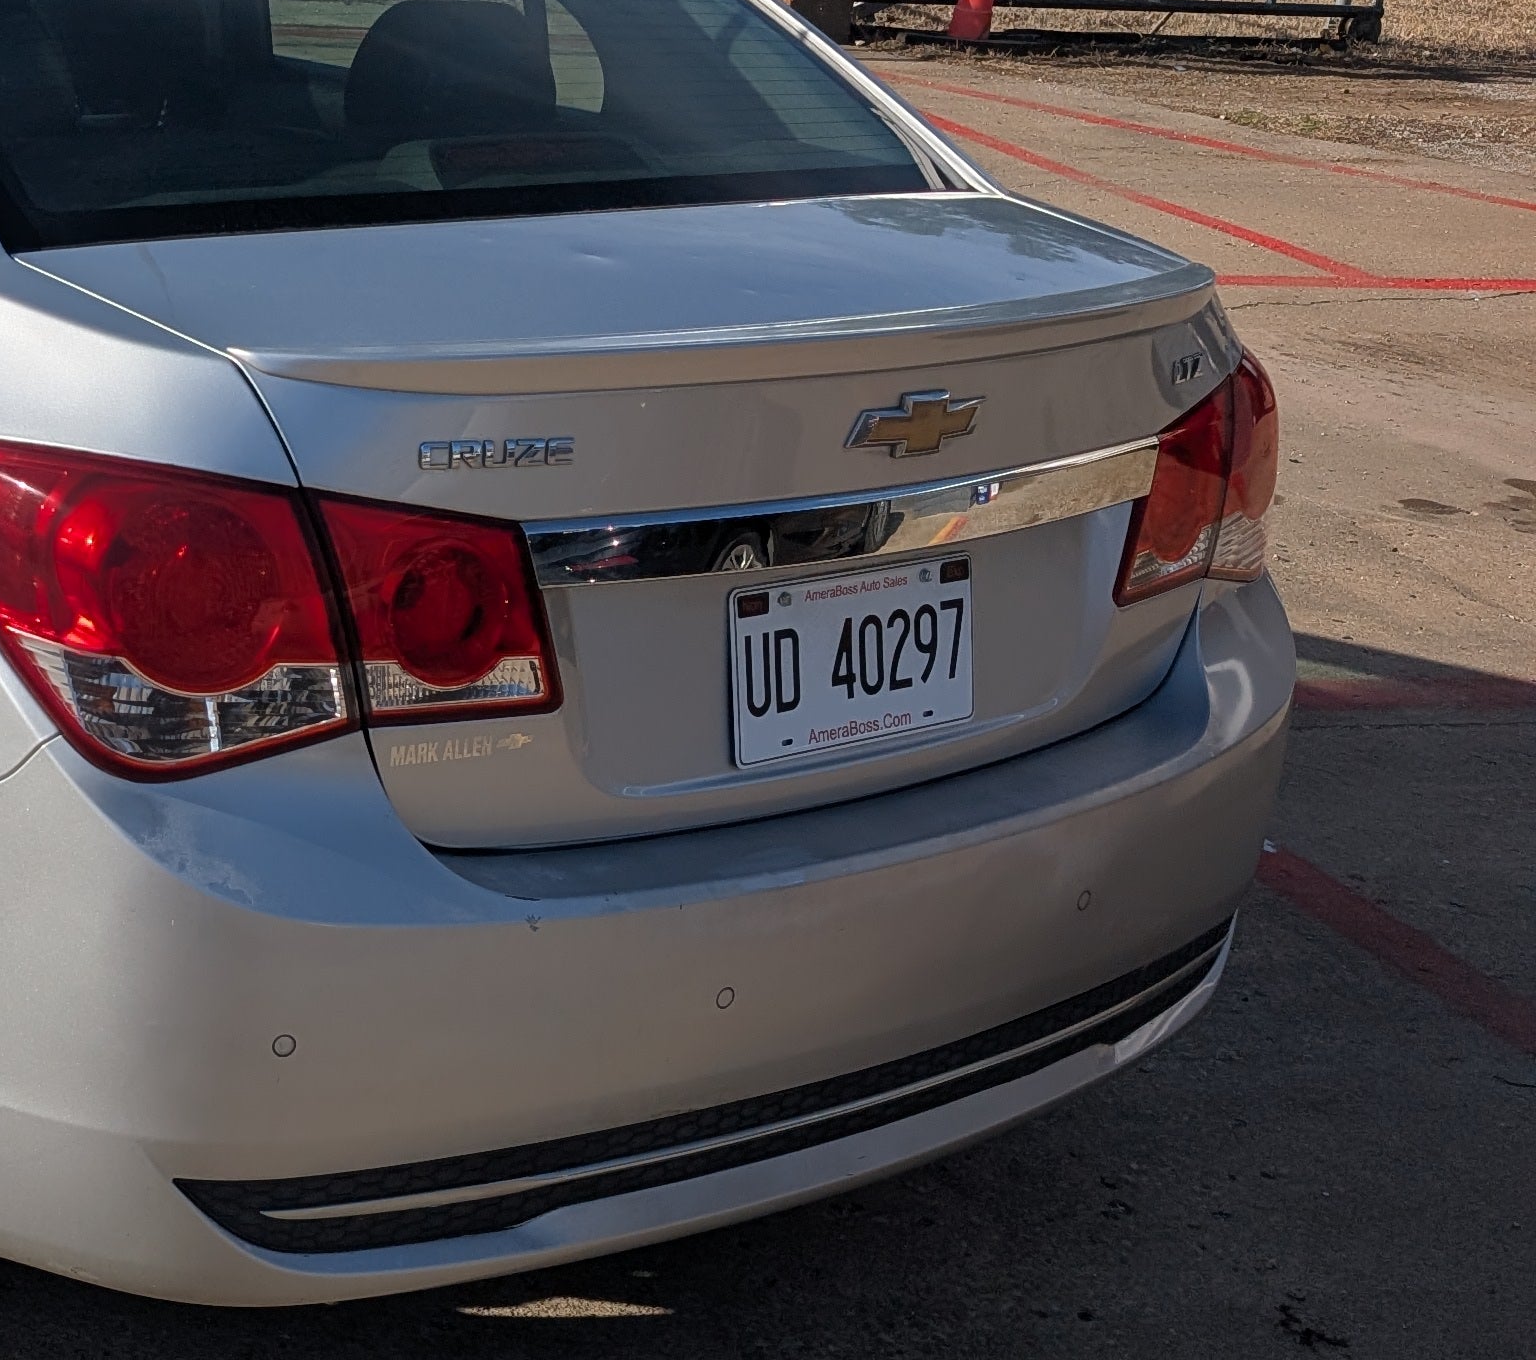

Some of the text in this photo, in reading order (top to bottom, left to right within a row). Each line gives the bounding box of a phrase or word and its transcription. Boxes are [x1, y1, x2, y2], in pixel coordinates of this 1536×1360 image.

[417, 436, 575, 471] CRUZE
[804, 575, 908, 603] AmeraBoss Auto Sales
[744, 598, 964, 718] UD 40297
[808, 712, 912, 745] AmeraBoss.Com
[389, 733, 494, 767] MARK ALLEN
